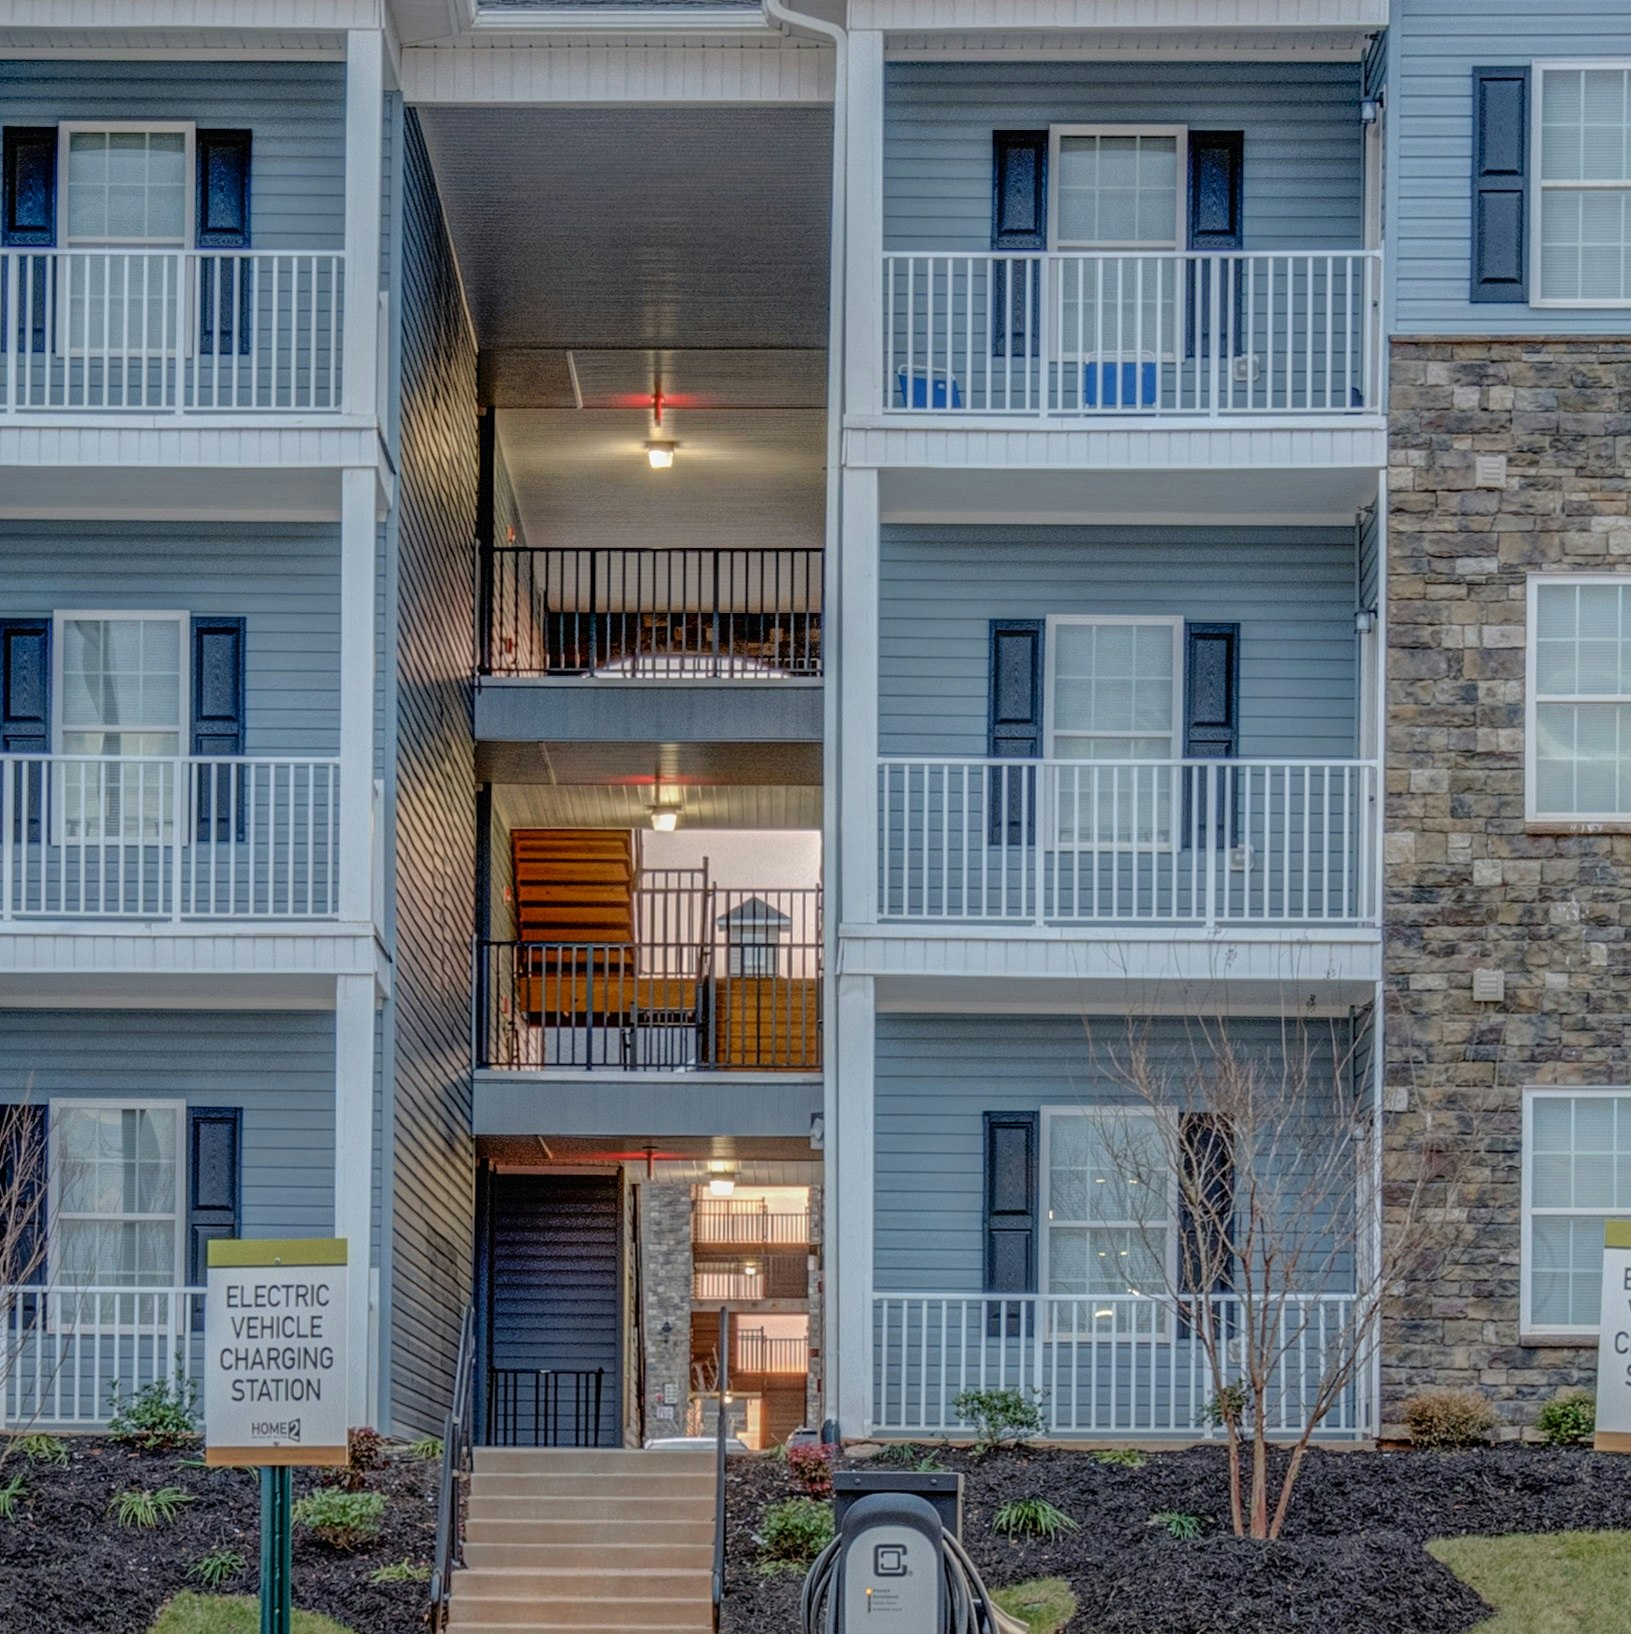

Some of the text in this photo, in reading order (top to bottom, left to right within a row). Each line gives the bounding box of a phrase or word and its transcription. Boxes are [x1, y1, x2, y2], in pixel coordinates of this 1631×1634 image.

[226, 1284, 330, 1308] ELECTRIC
[231, 1315, 323, 1339] VEHICLE
[219, 1346, 334, 1371] CHARGING
[231, 1378, 321, 1402] STATION
